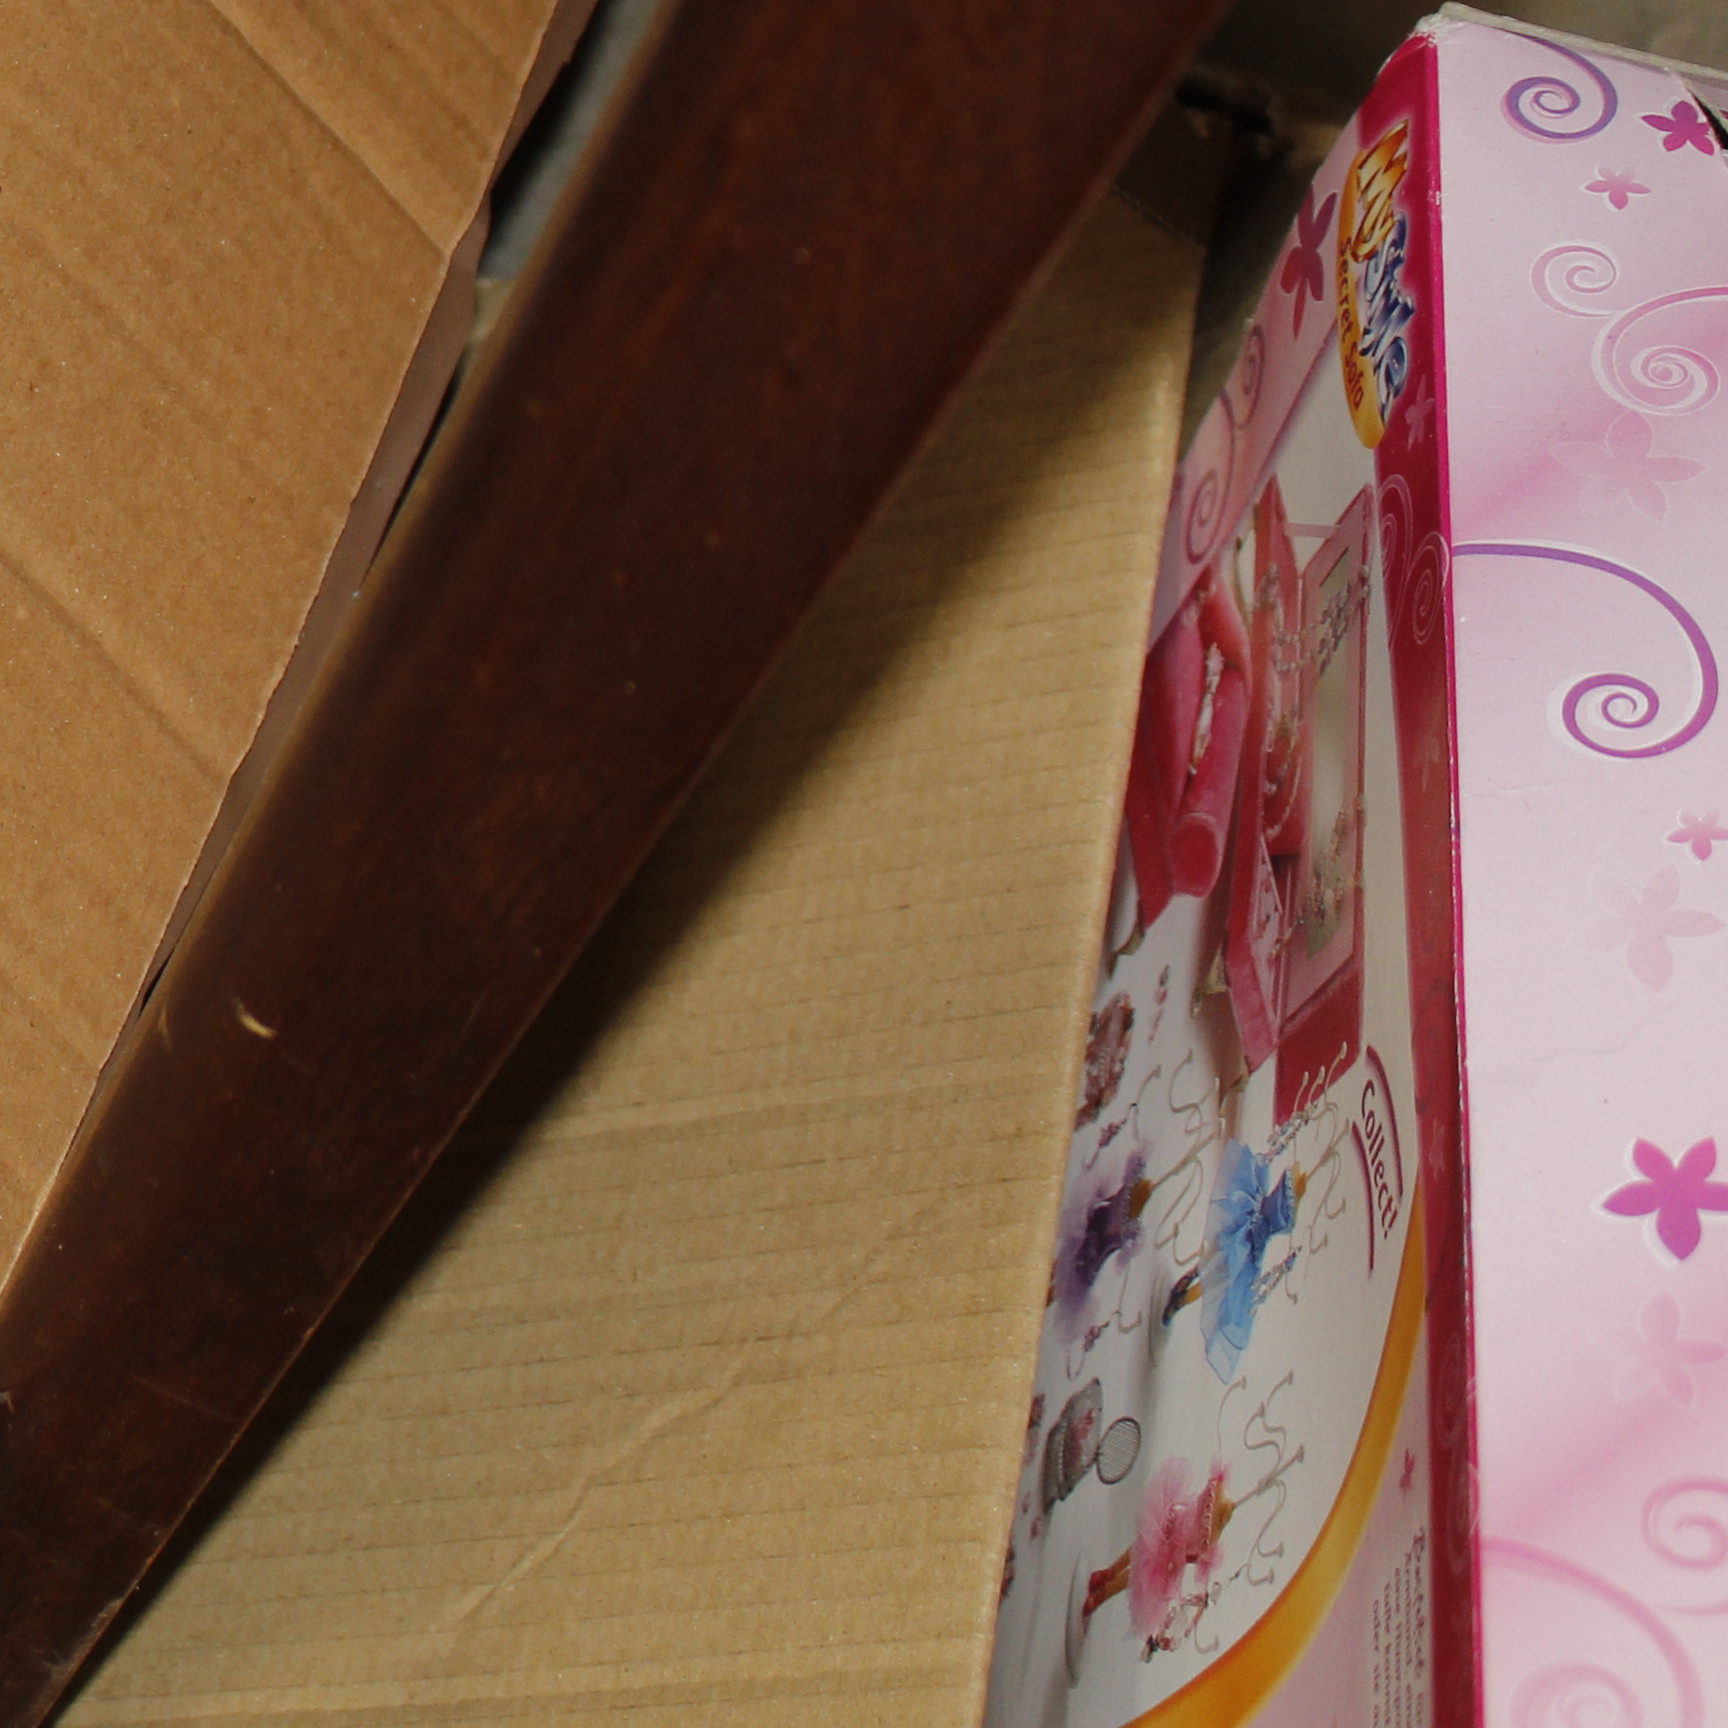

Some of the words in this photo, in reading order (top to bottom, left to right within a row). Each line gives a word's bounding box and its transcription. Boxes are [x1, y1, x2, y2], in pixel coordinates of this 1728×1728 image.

[1338, 235, 1355, 344] Secret
[1344, 344, 1365, 412] Sofa
[1361, 1079, 1398, 1240] Collect!
